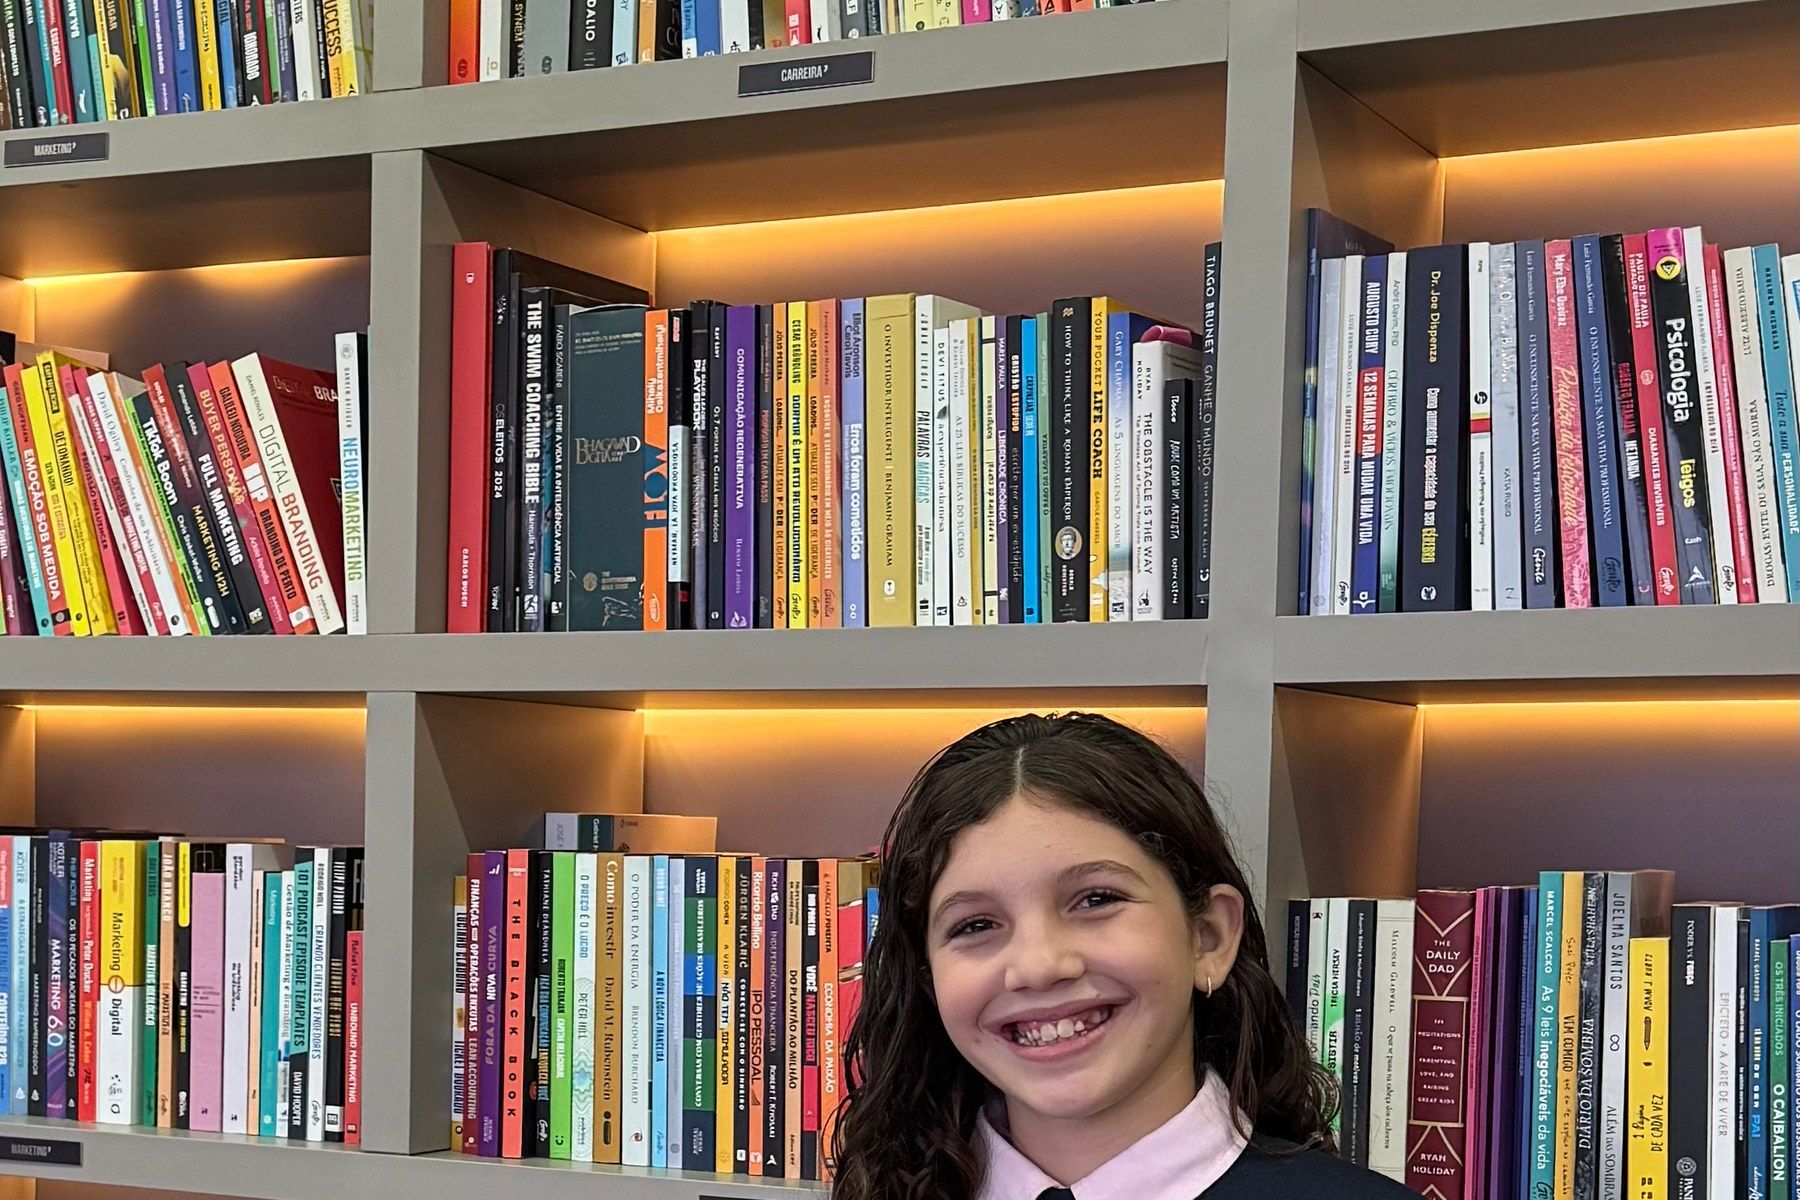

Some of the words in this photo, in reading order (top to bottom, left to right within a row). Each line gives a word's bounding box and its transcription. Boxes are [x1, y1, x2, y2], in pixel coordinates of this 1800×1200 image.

[324, 0, 342, 58] UCCESS
[1203, 255, 1217, 297] TIAGO
[1431, 271, 1442, 287] Dr.
[527, 301, 543, 329] THE
[1364, 282, 1381, 325] AUGUSTO
[1430, 290, 1442, 309] Joe
[884, 325, 895, 333] O
[1093, 312, 1104, 341] YOUR
[1202, 302, 1216, 354] BRUNET
[1363, 329, 1380, 353] CURY
[1429, 312, 1441, 363] Dispenza
[526, 334, 543, 377] SWIM
[884, 336, 895, 397] INVESTIDOR
[1093, 345, 1104, 387] POCKET
[1362, 371, 1379, 382] 12
[1665, 318, 1695, 422] Psicologia
[735, 348, 748, 428] COMUNICAÇÃO
[1092, 391, 1104, 424] LIFE
[1202, 364, 1215, 409] GANHE
[200, 390, 222, 432] BUYER
[525, 383, 542, 457] COACHING
[1142, 413, 1154, 437] THE
[1201, 413, 1214, 423] O
[1361, 385, 1378, 431] SEMANAS
[143, 417, 166, 460] TikTok
[850, 424, 863, 455] Erros
[884, 399, 895, 462] INTELIGENTE
[917, 411, 932, 458] PALAVRAS
[1201, 427, 1214, 476] MUNDO
[1360, 434, 1377, 458] PARA
[735, 430, 747, 509] REGENERATIVA
[850, 456, 863, 492] foram
[1092, 429, 1104, 480] COACH
[1142, 441, 1154, 502] OBSTACLE
[23, 449, 45, 510] EMOÇÃO
[154, 462, 181, 506] Boom
[524, 463, 541, 503] BIBLE
[885, 472, 895, 521] BENJAMIN
[917, 461, 932, 504] MÁGICAS
[1359, 461, 1376, 494] MUDAR
[1679, 459, 1697, 508] leigos
[1781, 453, 1799, 535] PERSONALIDADE
[37, 513, 50, 542] SOB
[199, 454, 217, 488] FULL
[208, 491, 243, 566] MARKETING
[258, 424, 291, 494] DIGITAL
[281, 494, 324, 590] BRANDING
[342, 437, 363, 582] NEUROMARKETING
[851, 493, 862, 560] cometidos
[1142, 506, 1153, 514] IS
[1359, 497, 1375, 518] UMA
[193, 505, 220, 571] MARKETING
[885, 525, 895, 567] GRAHAM
[1142, 518, 1153, 541] THE
[1358, 521, 1375, 545] VIDA
[42, 544, 61, 600] MEDIDA
[1142, 546, 1153, 576] WAY
[295, 869, 309, 885] 101
[605, 861, 618, 903] Como
[295, 890, 309, 936] PODCAST
[511, 900, 522, 940] THE
[604, 906, 617, 958] investir
[1611, 893, 1626, 938] JOELMA
[111, 913, 126, 971] Marketing
[294, 942, 307, 983] EPISODE
[1426, 950, 1460, 960] DAILY
[50, 940, 62, 1009] MARKETING
[1428, 964, 1455, 974] DAD
[1609, 944, 1624, 990] SANTOS
[508, 960, 520, 1035] BLACK
[604, 977, 615, 1010] David
[752, 990, 763, 1013] IPO
[1537, 1005, 1553, 1013] 9
[1538, 985, 1554, 1001] As
[47, 1016, 65, 1046] 6.0
[110, 998, 125, 1035] Digital
[294, 989, 306, 1047] TEMPLATES
[604, 1014, 614, 1028] M.
[1537, 1017, 1553, 1036] leis
[1718, 992, 1731, 1039] EPICTETO
[602, 1033, 614, 1101] Rubenstein
[751, 1018, 763, 1085] PESSOAL
[1718, 1050, 1730, 1058] A
[506, 1056, 518, 1117] BOOK
[1535, 1040, 1552, 1120] inegociáveis
[1717, 1061, 1730, 1085] ARTE
[1772, 1084, 1785, 1094] O
[1717, 1088, 1730, 1103] DE
[1535, 1124, 1550, 1139] da
[1717, 1107, 1729, 1136] VIVER
[1772, 1099, 1785, 1180] CAIBALION
[1413, 1165, 1456, 1175] HOLIDAY
[1420, 1153, 1447, 1162] RYAN
[1534, 1143, 1550, 1169] vida
